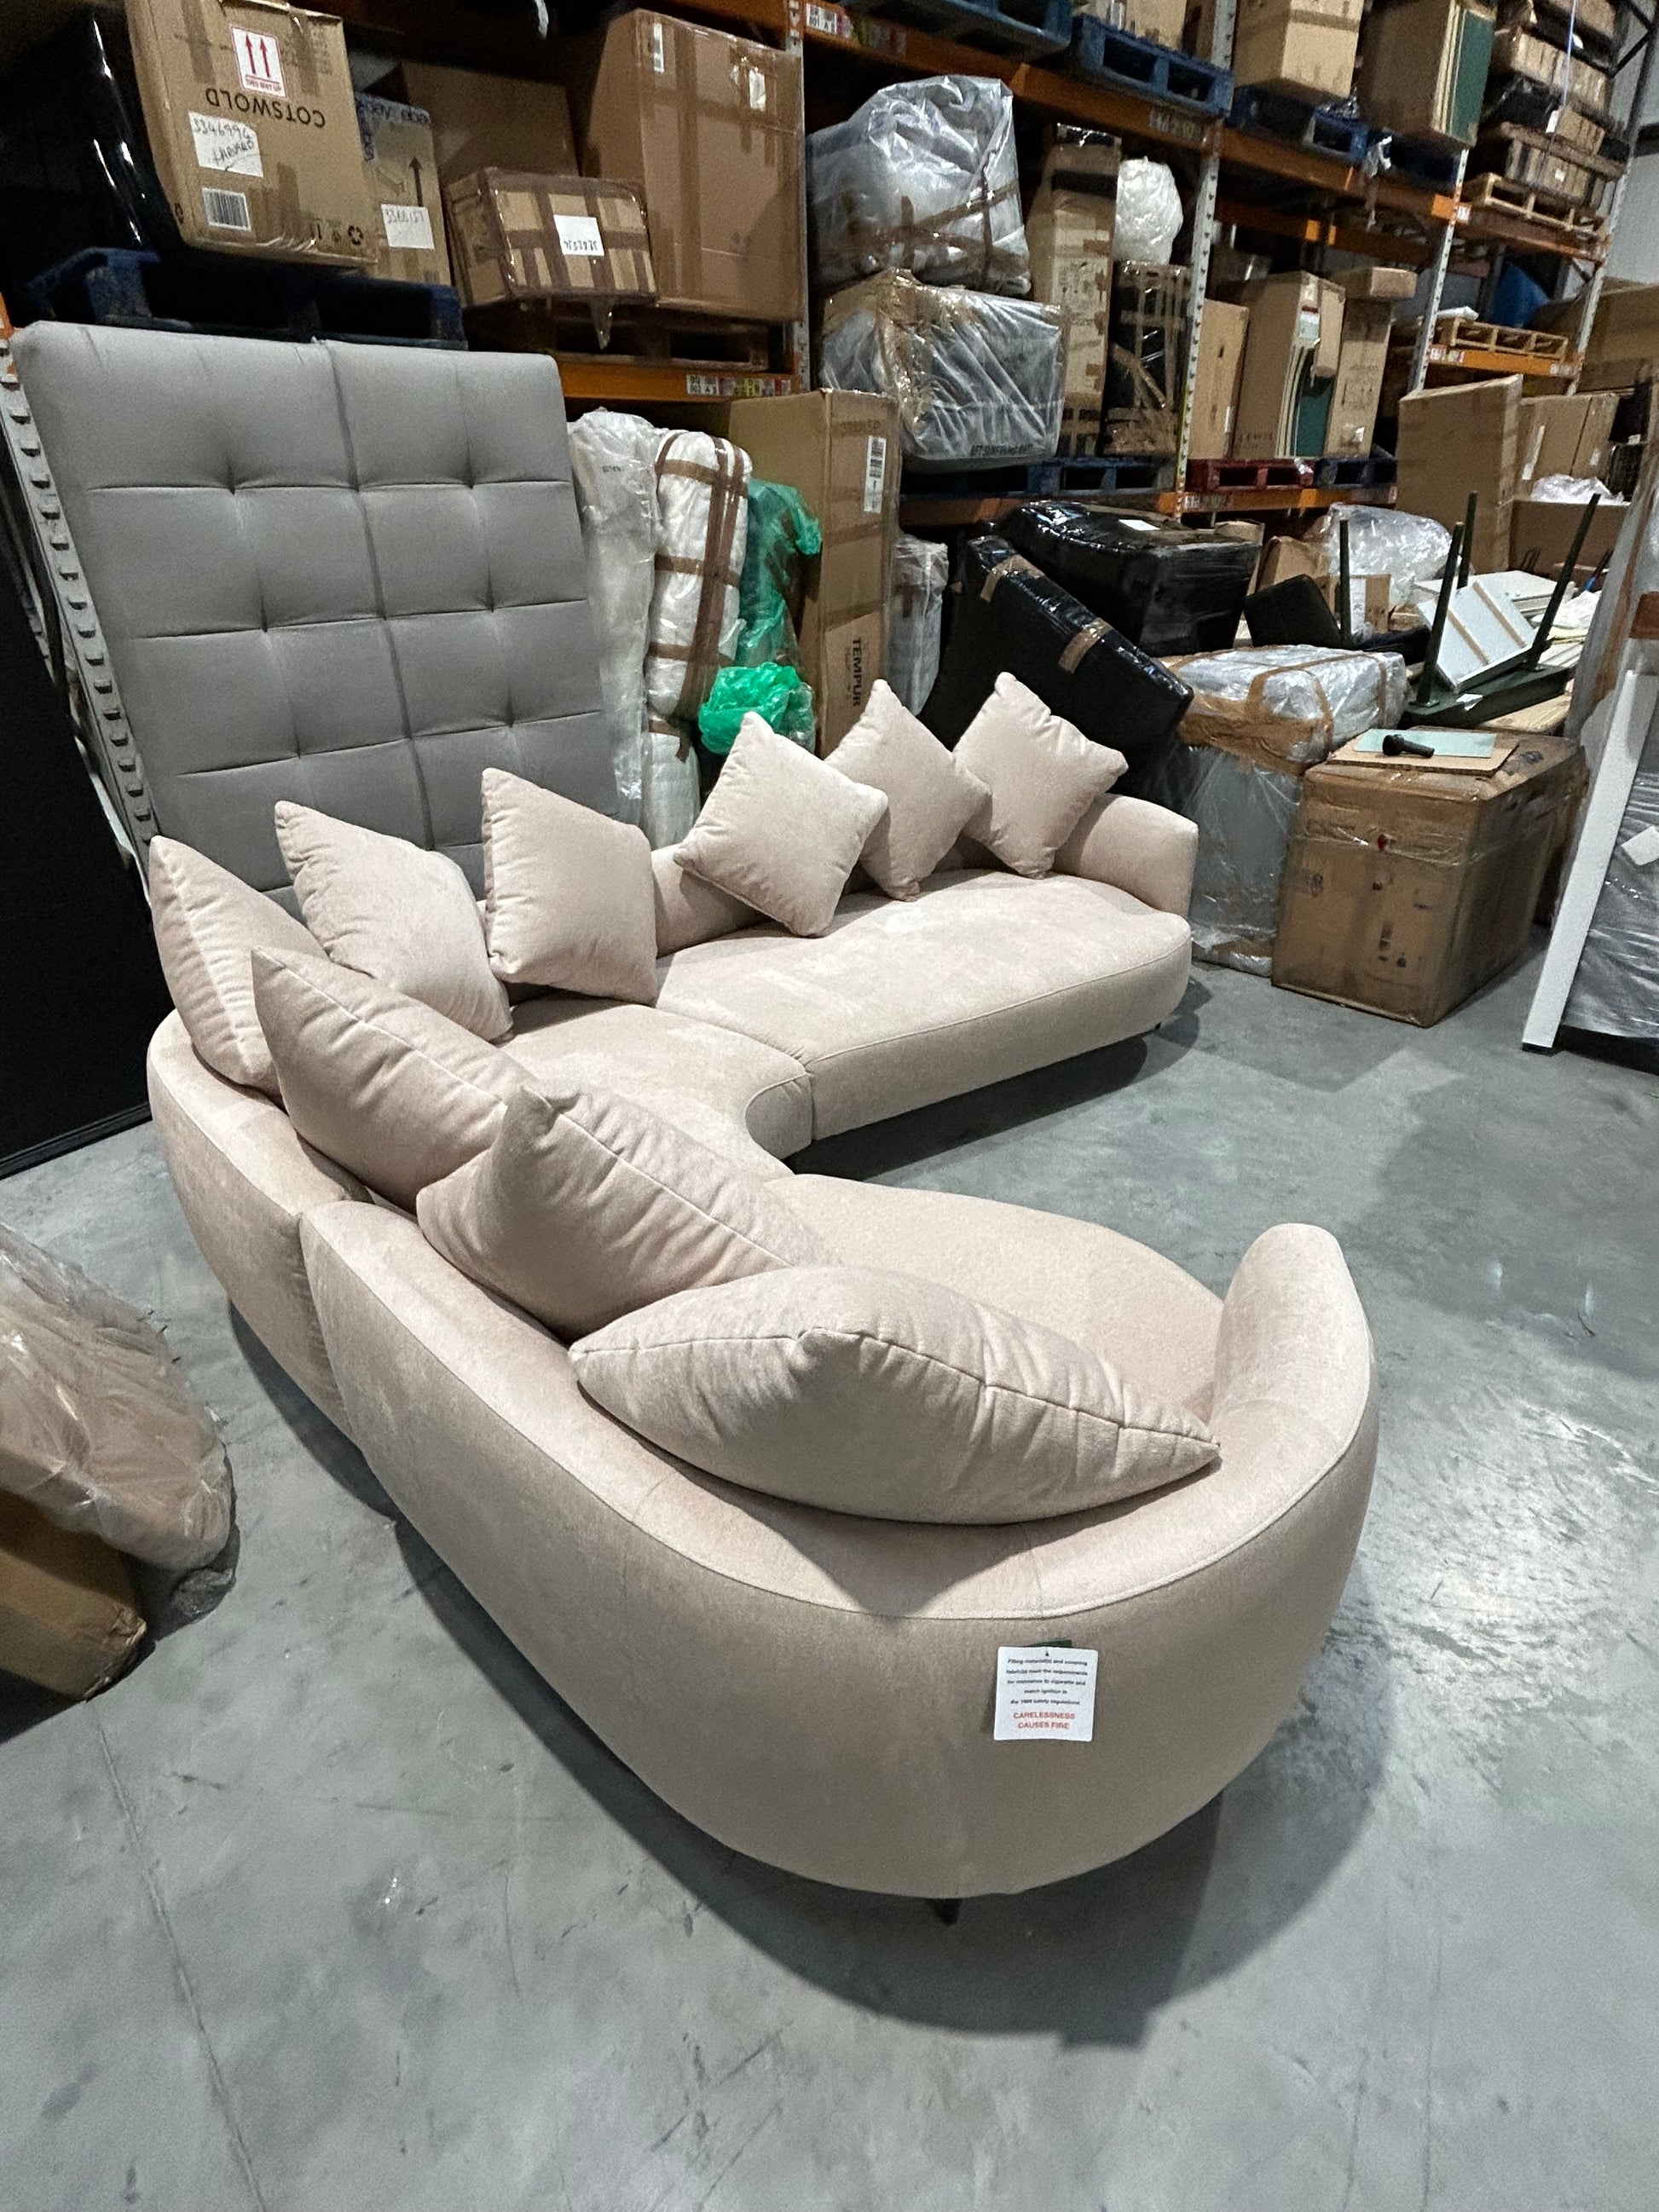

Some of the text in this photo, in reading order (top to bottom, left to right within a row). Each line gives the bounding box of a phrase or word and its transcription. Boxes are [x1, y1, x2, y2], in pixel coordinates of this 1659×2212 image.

[205, 88, 326, 128] COTSWOLD
[852, 637, 863, 707] TEMPUR
[1013, 1712, 1076, 1720] CARELESSNESS
